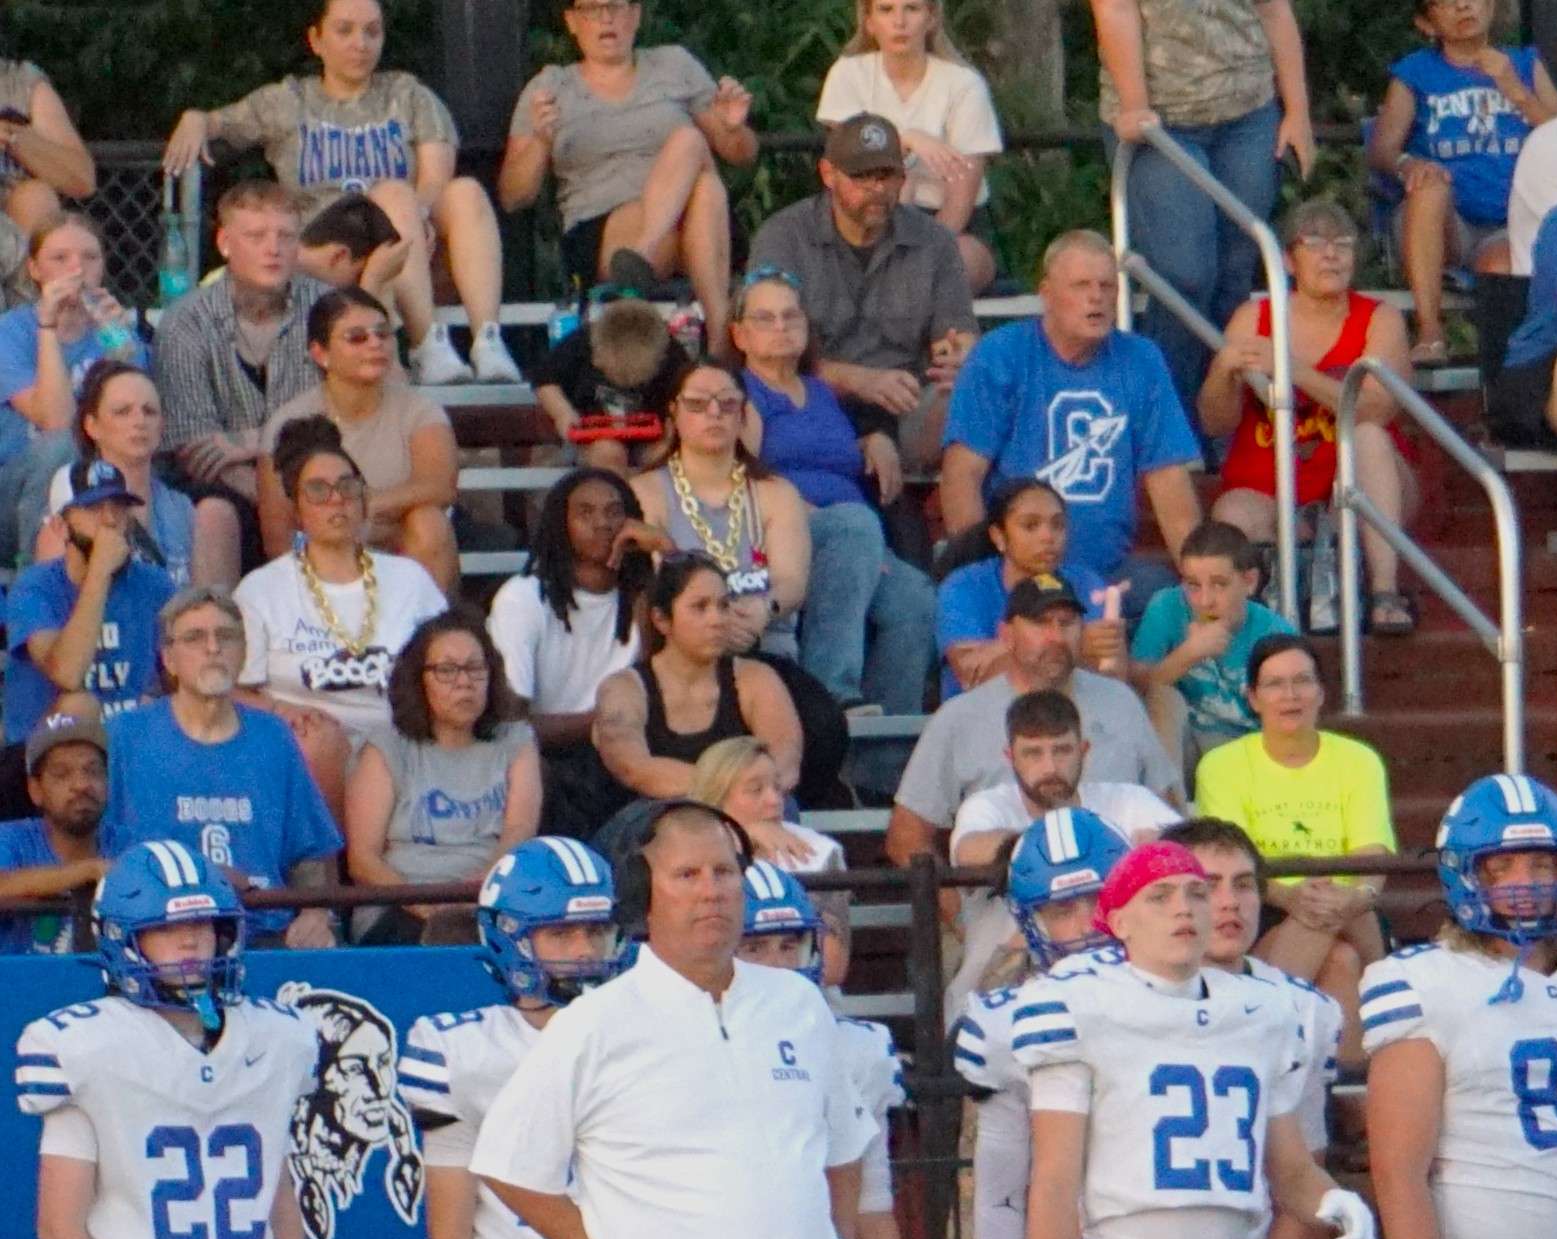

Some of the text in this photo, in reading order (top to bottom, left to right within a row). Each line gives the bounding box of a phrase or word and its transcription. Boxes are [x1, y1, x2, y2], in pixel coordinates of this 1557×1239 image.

[1426, 87, 1522, 134] CENTRA
[298, 118, 409, 188] INDIANS
[202, 823, 234, 868] 6
[1256, 838, 1337, 852] MARATHO
[1196, 1008, 1209, 1026] C
[778, 1040, 797, 1067] C
[201, 1065, 214, 1083] C
[771, 1068, 813, 1083] CENTRAL
[1149, 1063, 1262, 1193] 23
